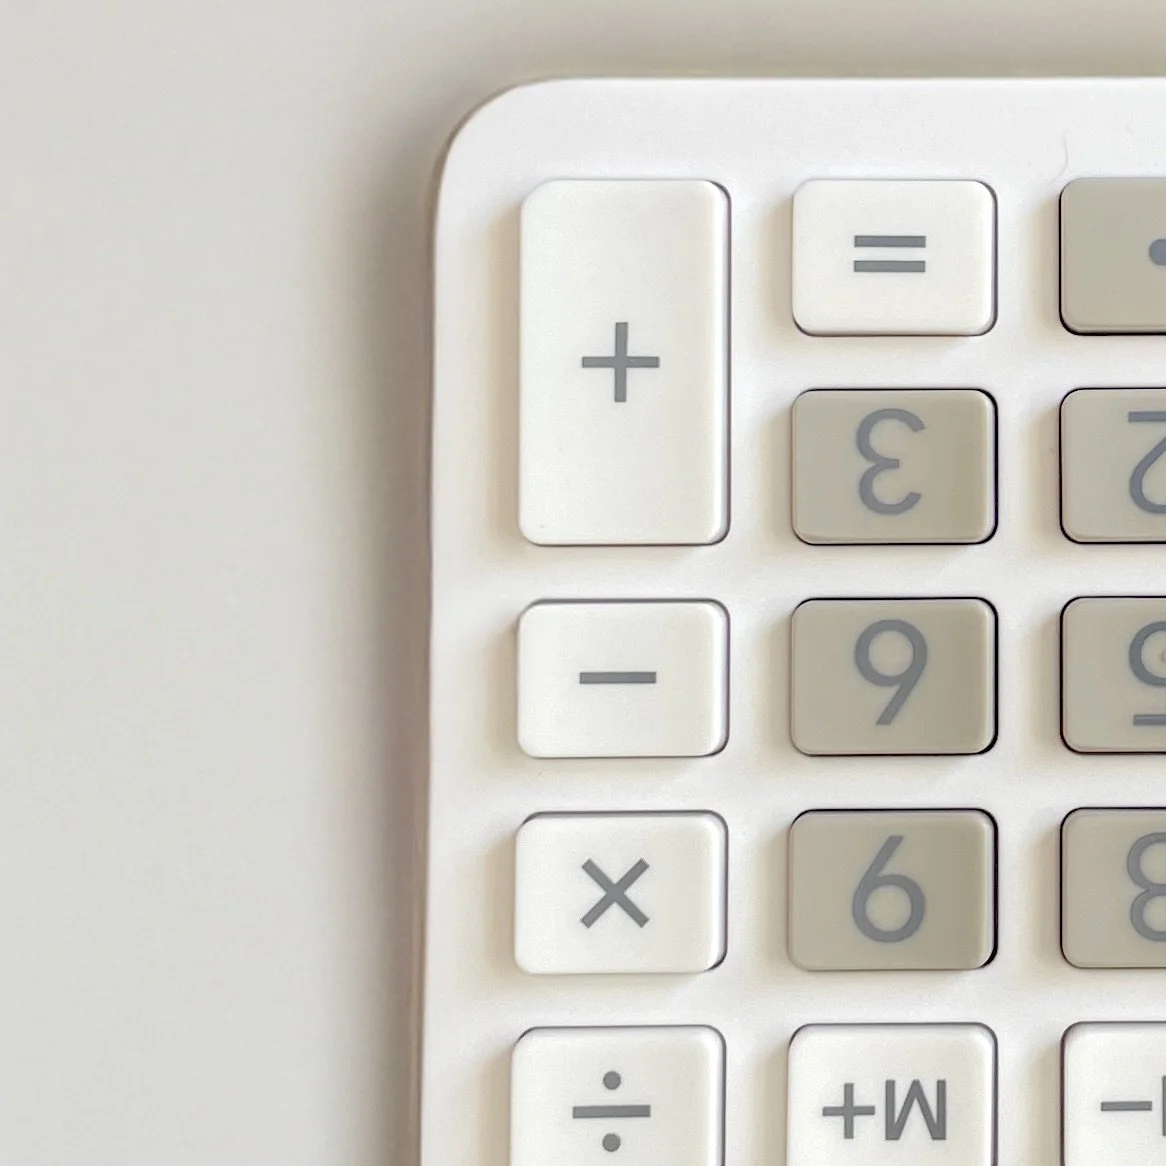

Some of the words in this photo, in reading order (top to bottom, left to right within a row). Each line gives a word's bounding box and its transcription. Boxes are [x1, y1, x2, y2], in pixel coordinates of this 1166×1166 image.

[853, 234, 927, 274] =
[581, 321, 661, 403] +
[855, 407, 927, 516] 3
[853, 618, 929, 726] 6
[579, 857, 651, 929] ×
[851, 834, 928, 944] 9
[572, 1070, 652, 1153] ÷
[821, 1078, 947, 1142] M+
